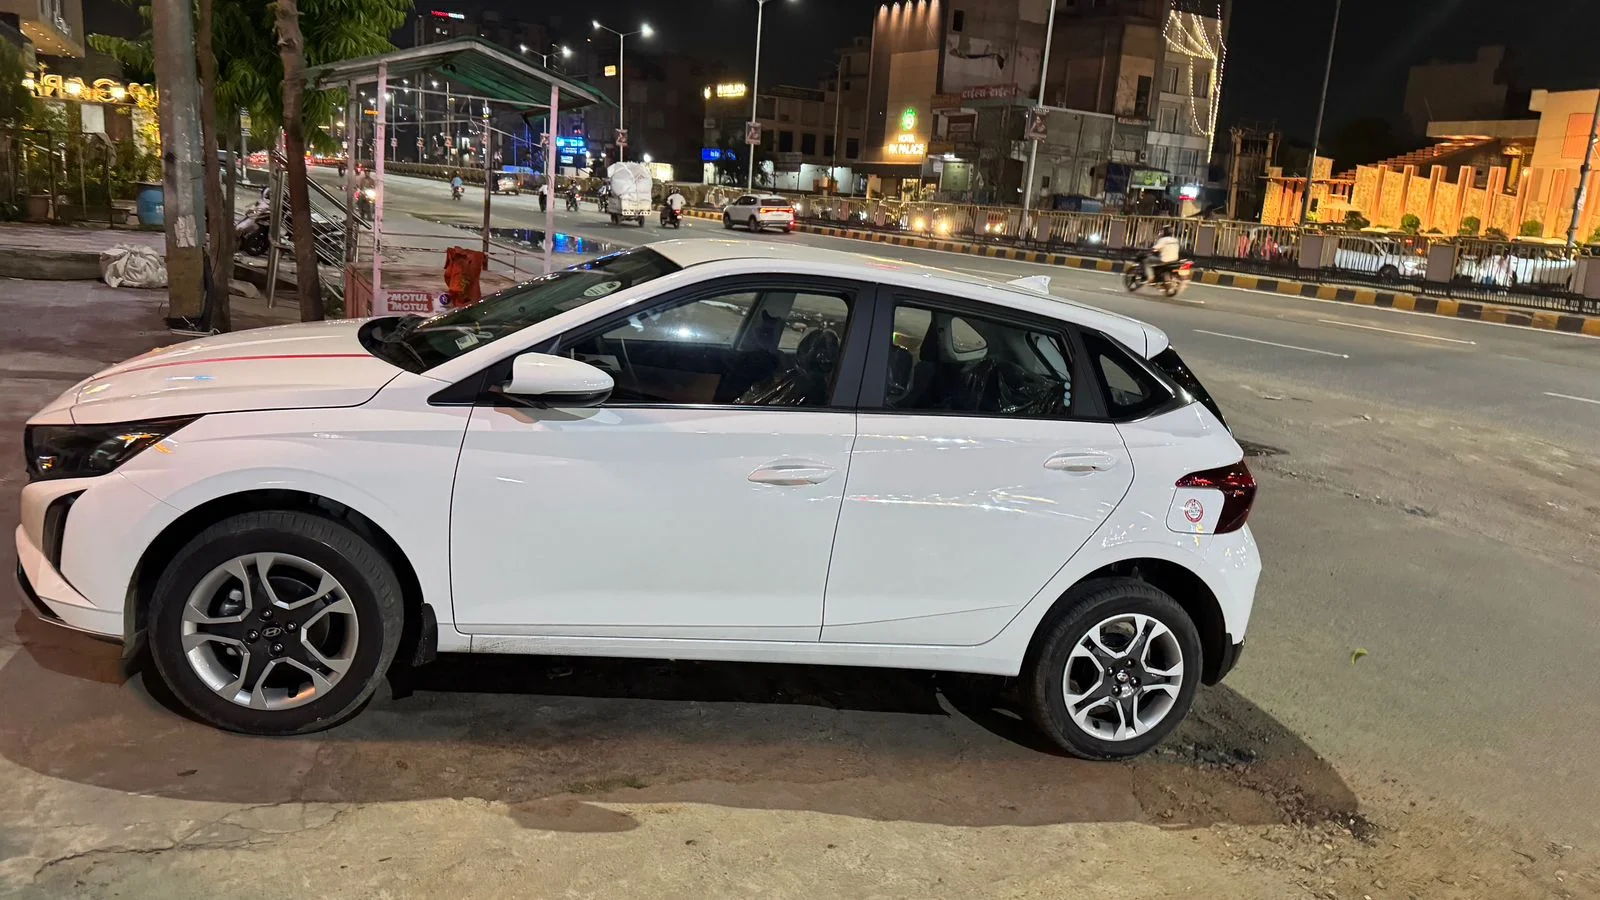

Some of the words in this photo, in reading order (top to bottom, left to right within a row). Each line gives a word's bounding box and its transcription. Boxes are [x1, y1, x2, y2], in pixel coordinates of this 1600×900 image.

[898, 143, 924, 155] PALACE
[389, 293, 428, 302] MOTUL
[390, 302, 429, 311] MOTUL
